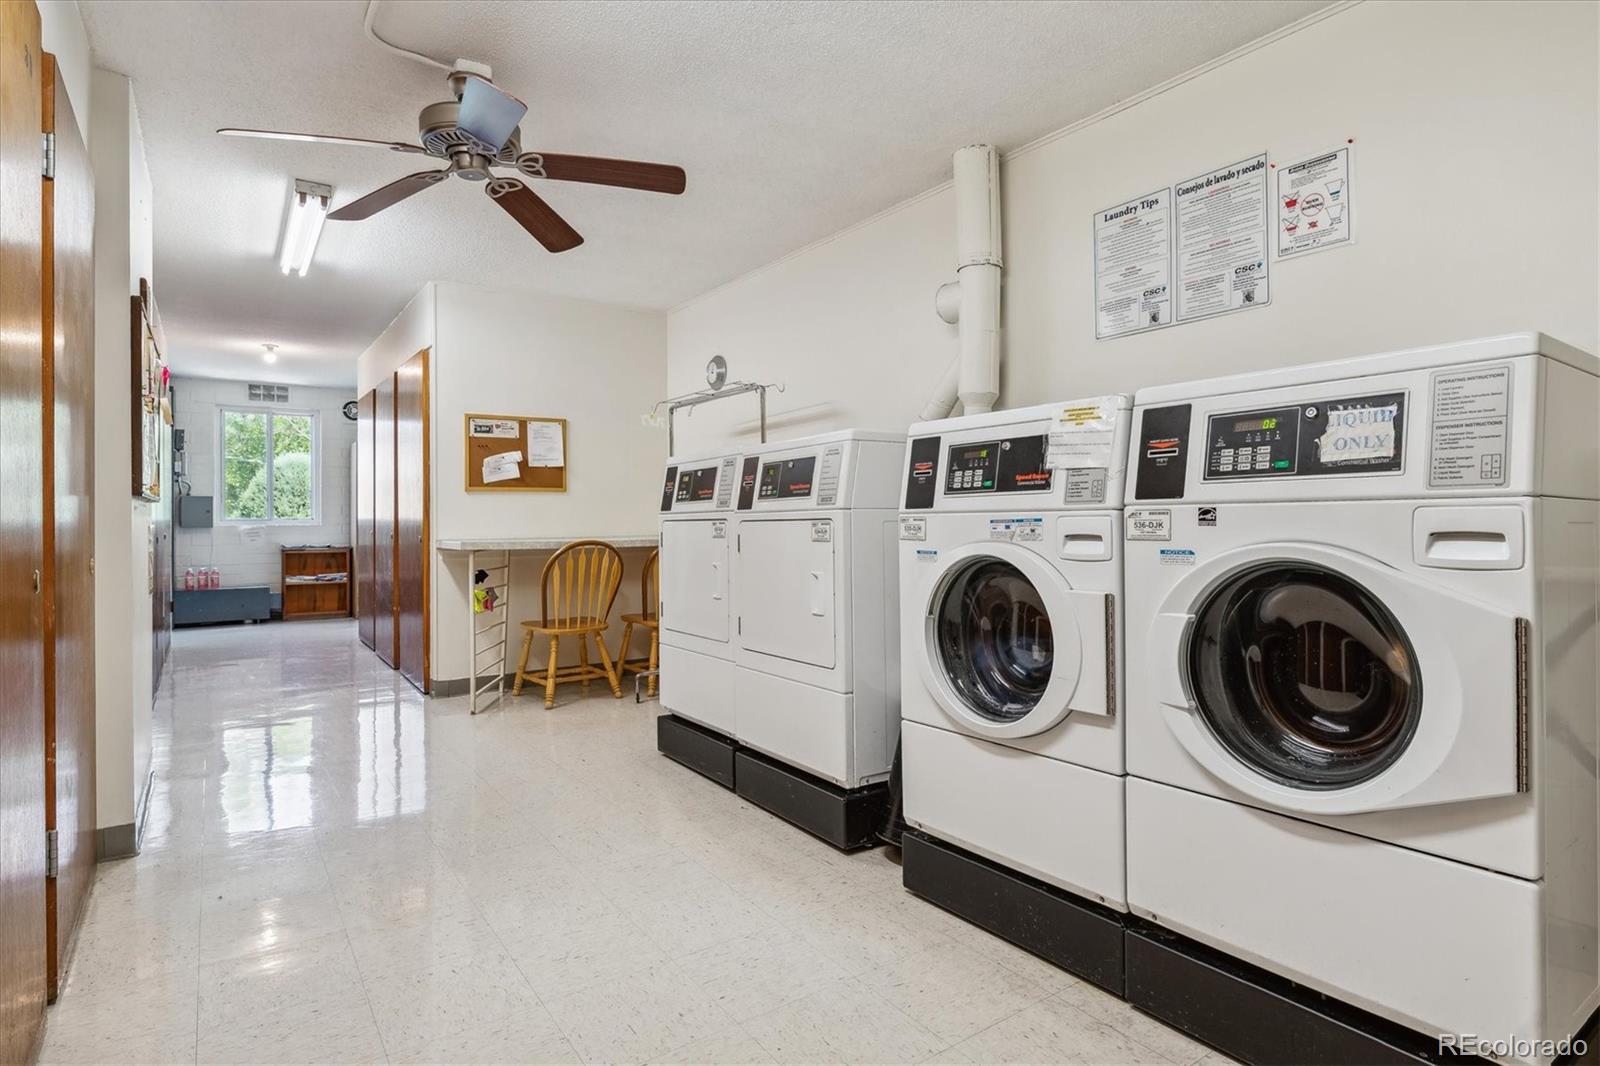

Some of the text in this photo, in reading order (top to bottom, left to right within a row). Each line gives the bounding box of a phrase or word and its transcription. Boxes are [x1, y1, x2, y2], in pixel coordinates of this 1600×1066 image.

[1177, 160, 1265, 197] Consejos de lavado y secado
[1104, 197, 1159, 222] Laundry Tips
[1235, 264, 1256, 275] CSC
[1143, 287, 1160, 297] CSC
[1334, 434, 1389, 450] ONLY
